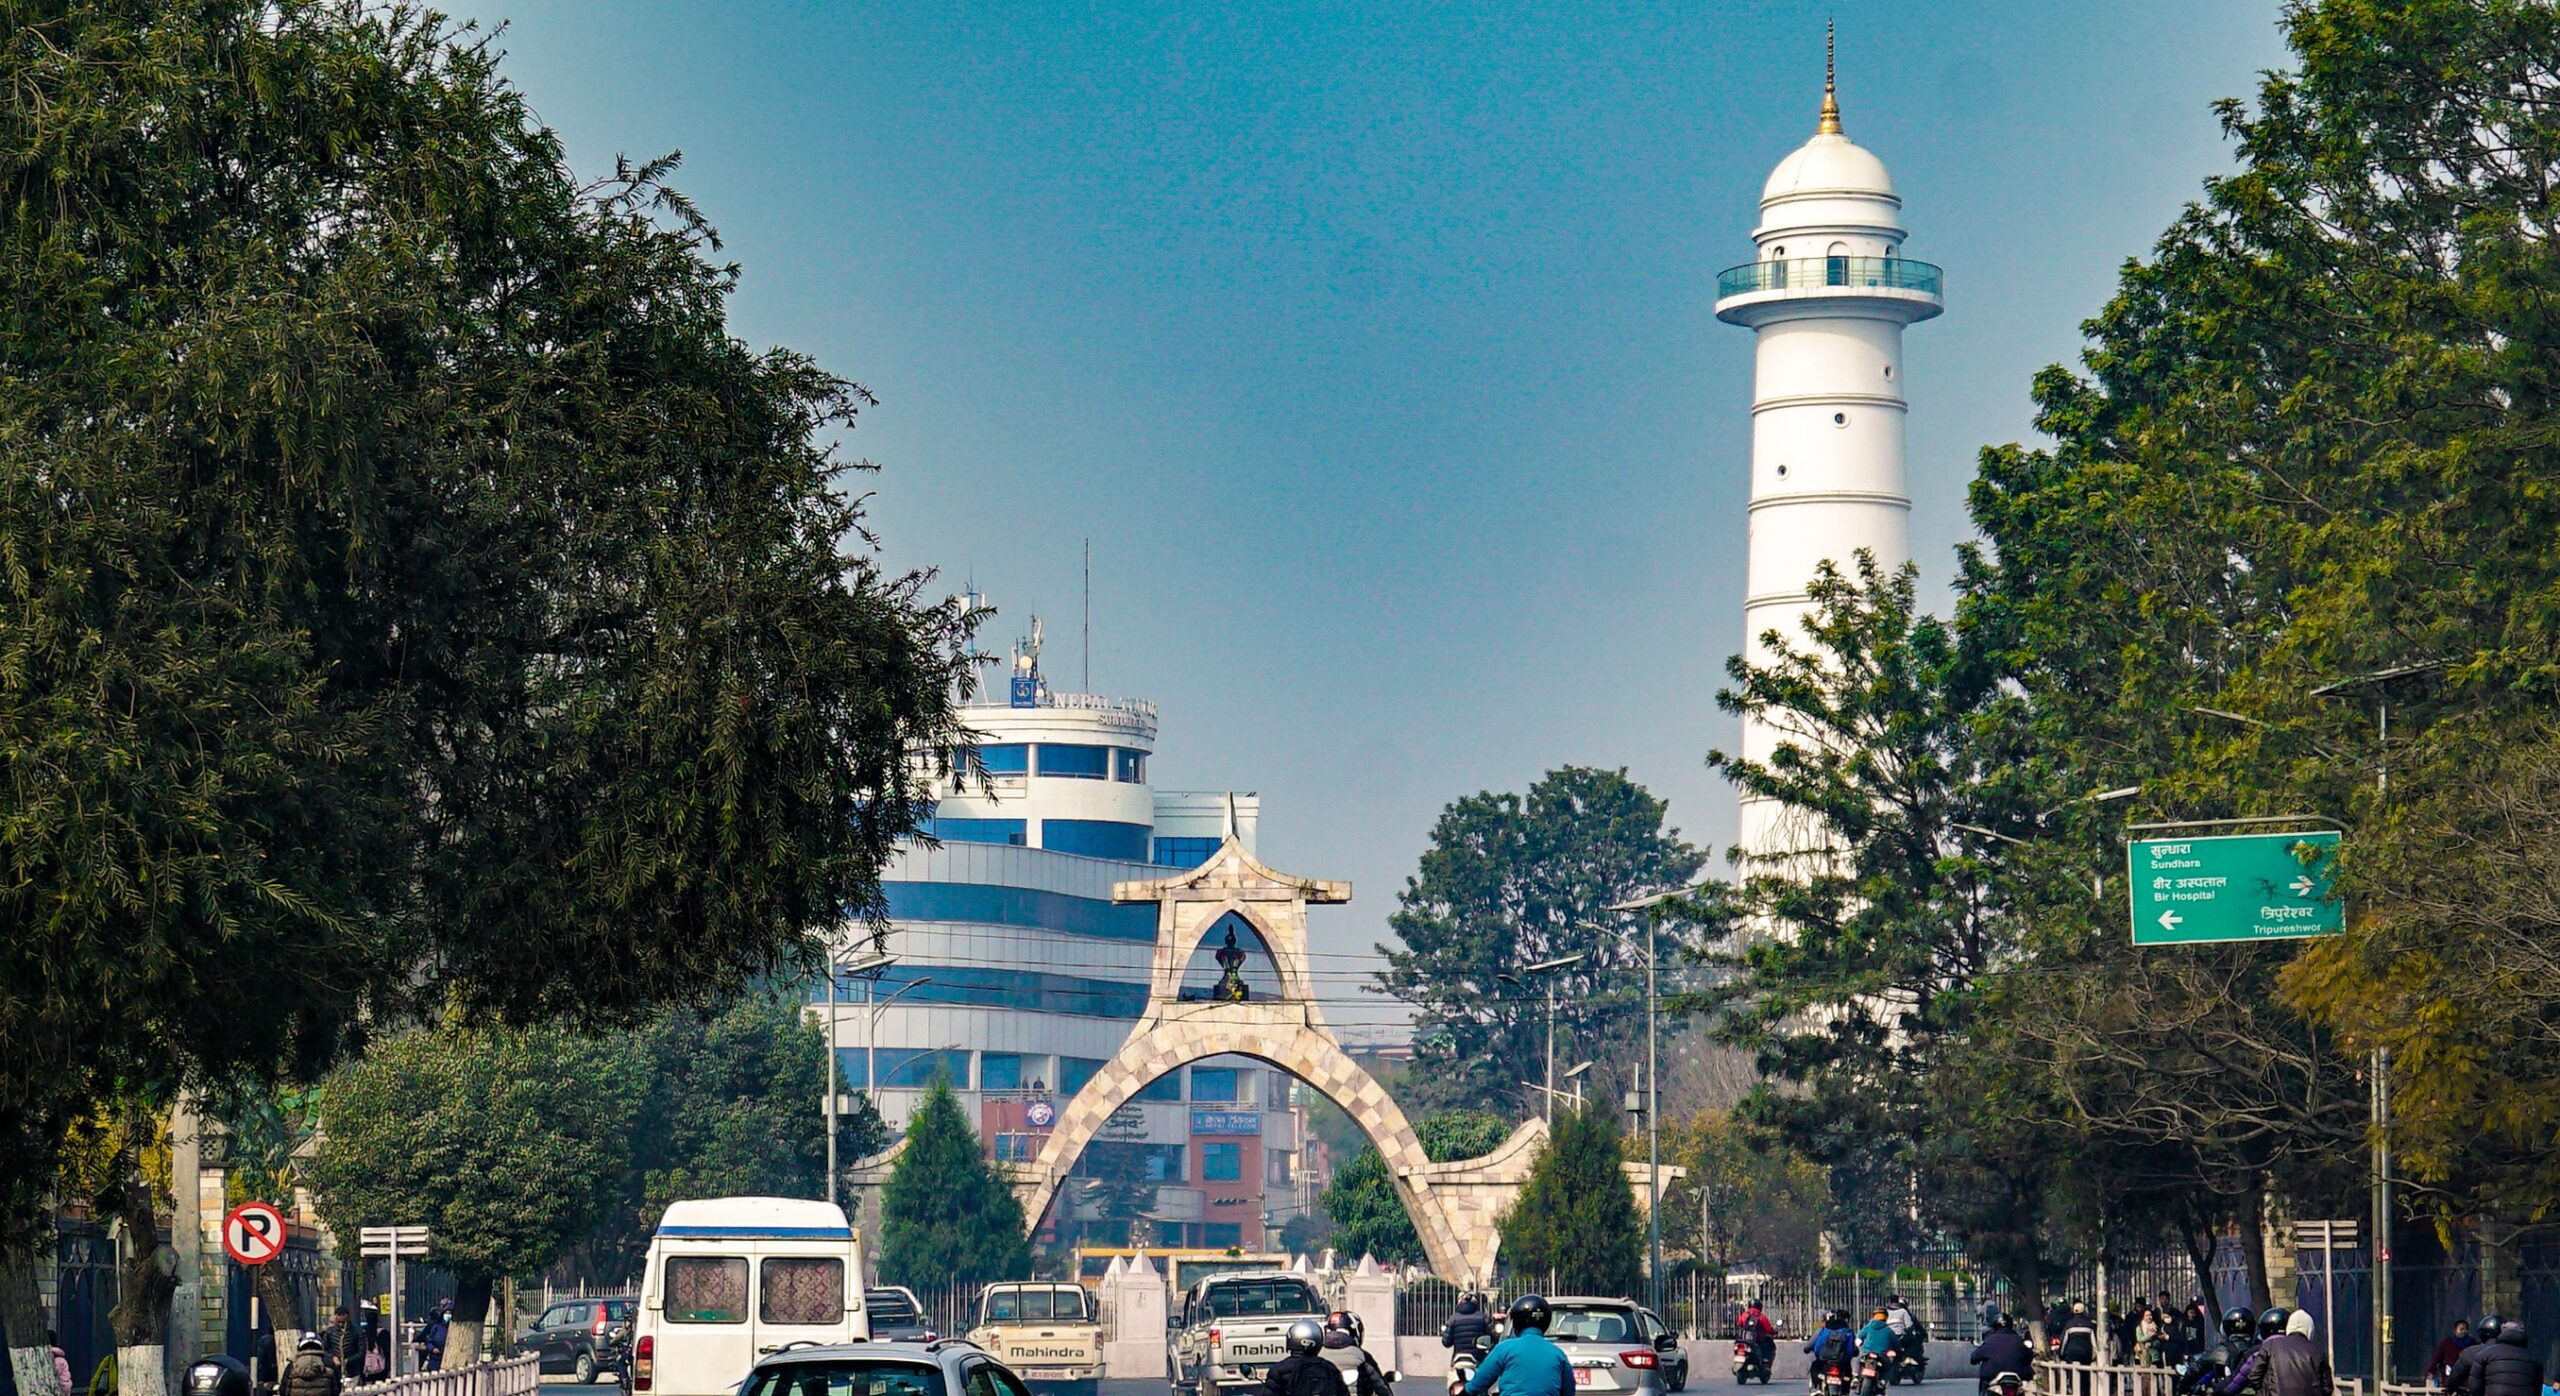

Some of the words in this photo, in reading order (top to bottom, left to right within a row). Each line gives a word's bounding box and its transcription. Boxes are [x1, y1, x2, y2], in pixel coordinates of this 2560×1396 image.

[2150, 844, 2191, 859] सुन्धारा
[2151, 859, 2201, 869] Sundhara
[2153, 876, 2172, 889] वीर
[2176, 877, 2227, 889] अस्पताल
[2154, 892, 2169, 902] Bir
[2172, 890, 2215, 902] Hospital
[2253, 923, 2321, 935] Tripureshwor
[242, 1214, 271, 1252] P
[1010, 1347, 1085, 1357] Mahindra
[1233, 1343, 1288, 1356] Mahin
